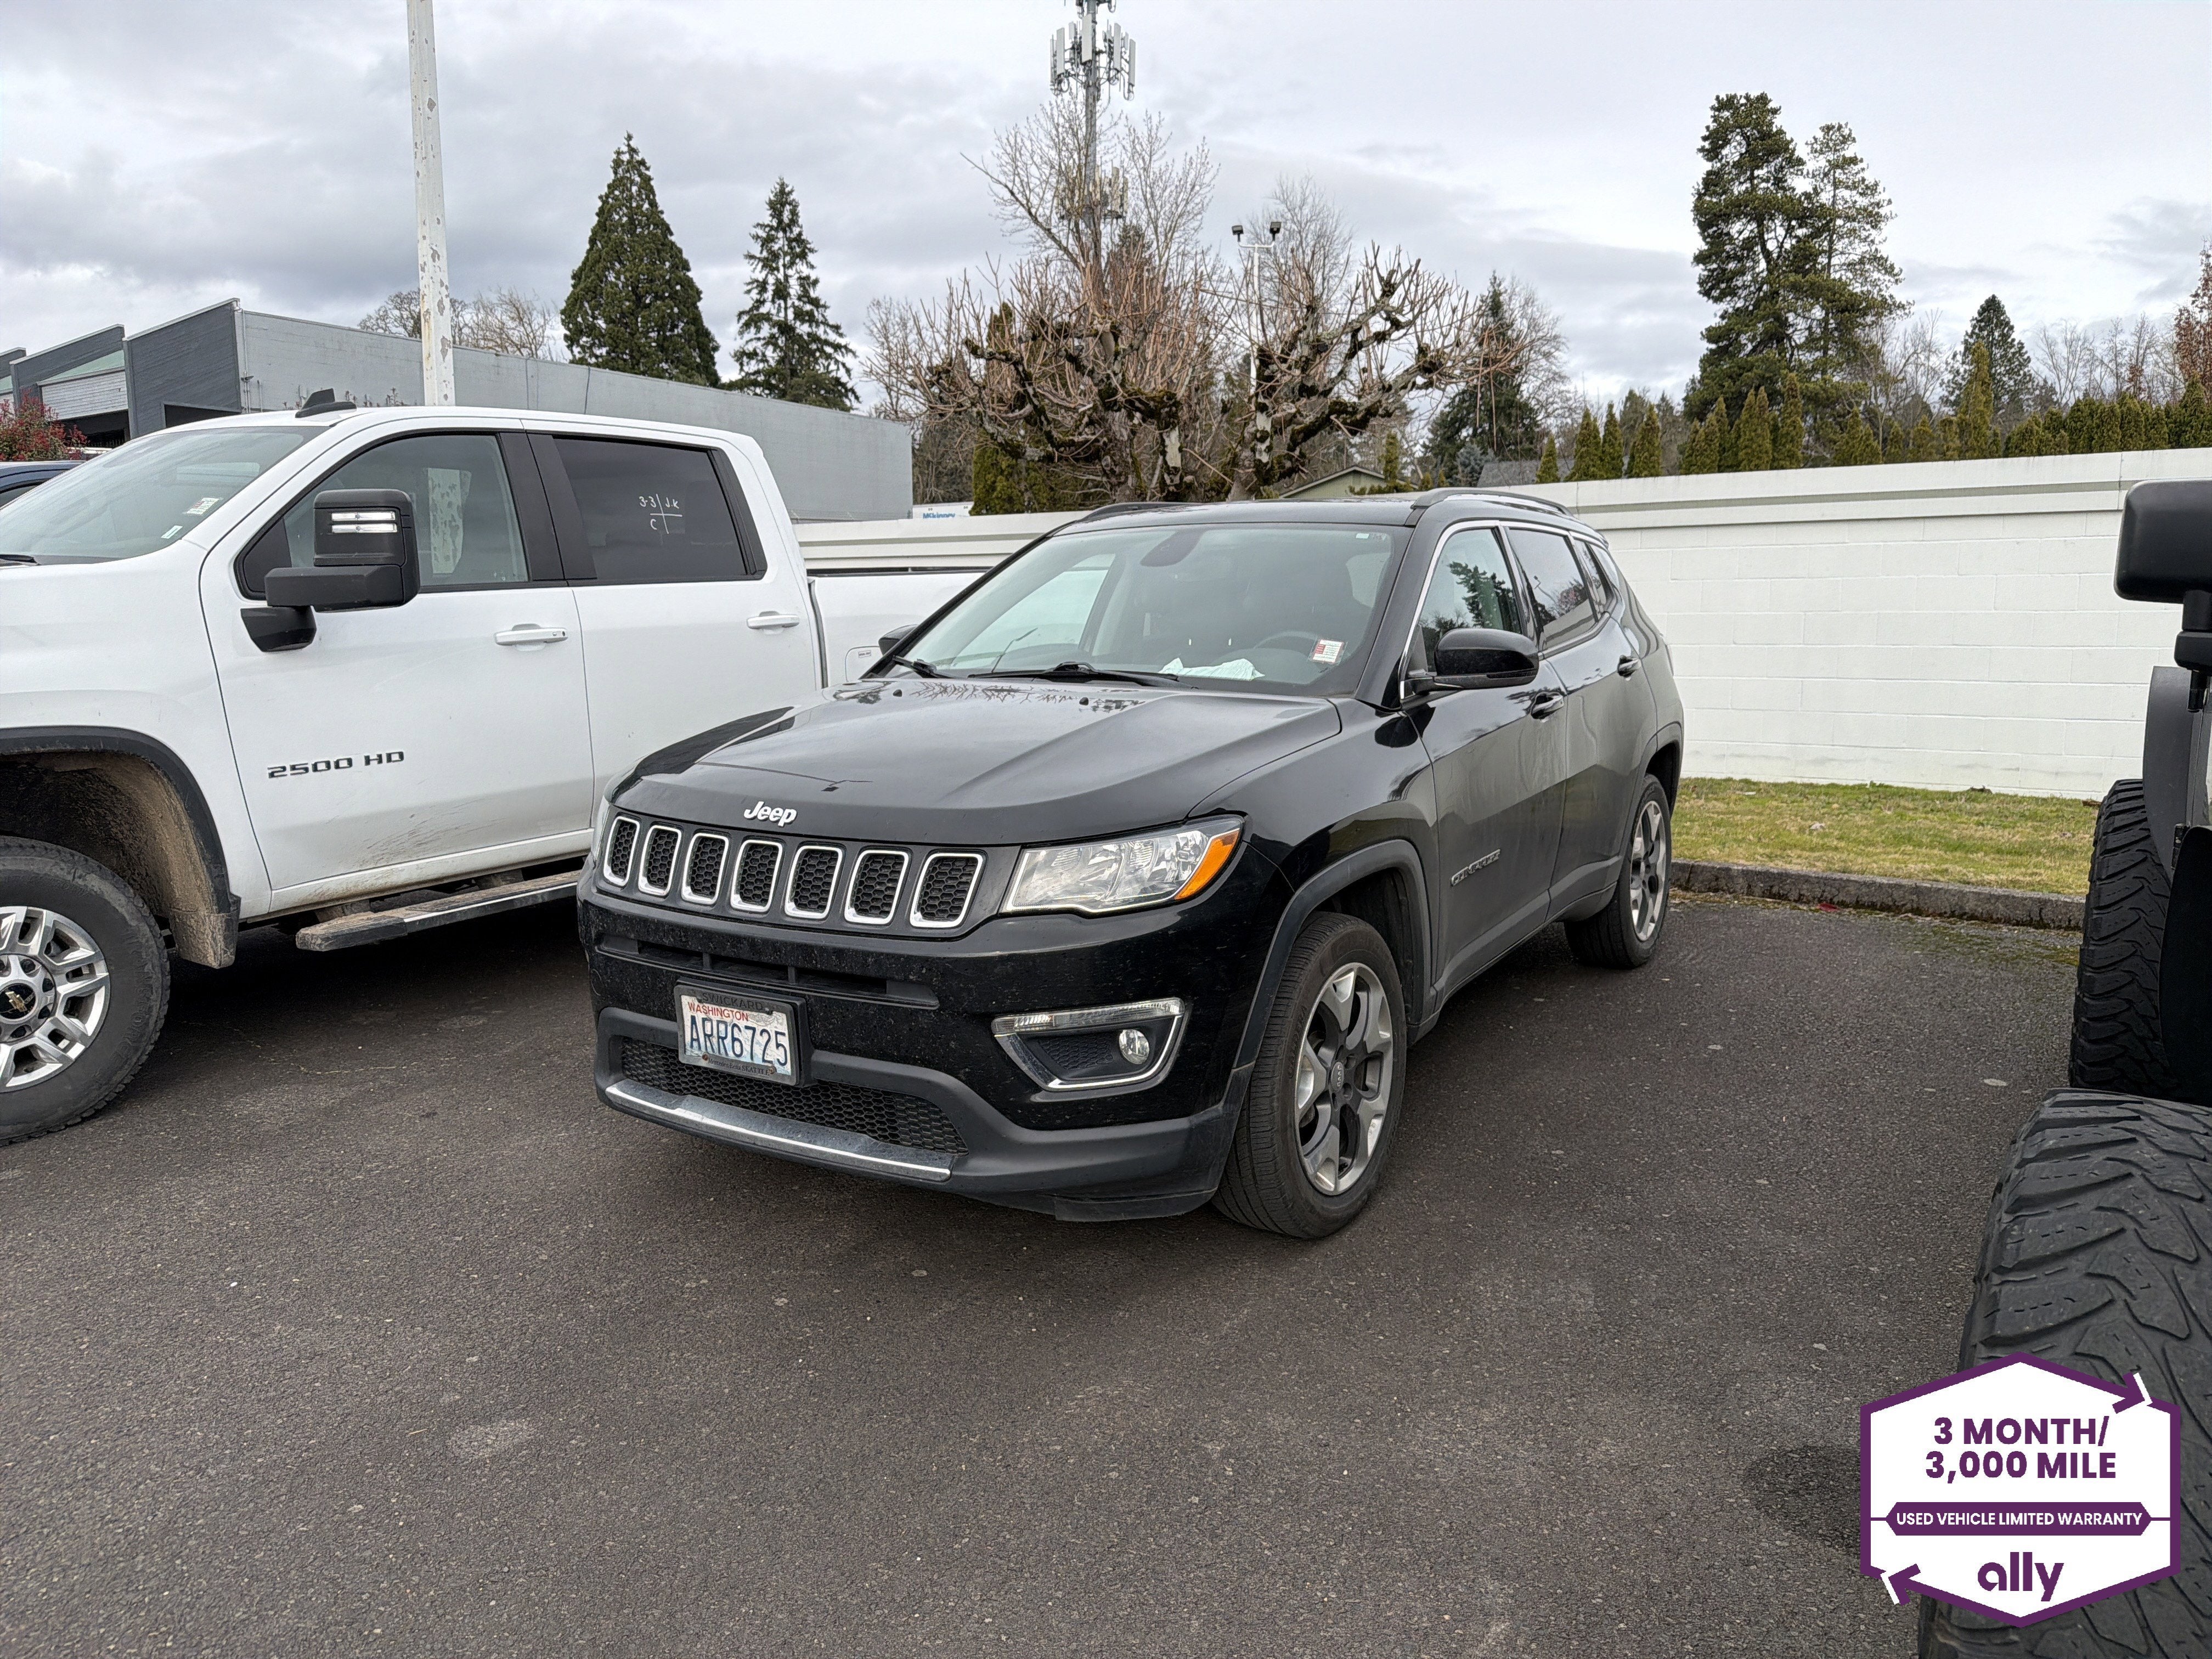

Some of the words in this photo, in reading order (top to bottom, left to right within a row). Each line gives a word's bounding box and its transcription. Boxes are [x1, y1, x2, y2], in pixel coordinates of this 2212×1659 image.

[267, 757, 353, 778] 2500
[364, 751, 404, 766] HD
[743, 801, 797, 827] Jeep
[687, 1002, 749, 1022] WASHINGTON
[702, 992, 764, 1011] SWICKARD
[690, 1015, 788, 1066] ARR6725
